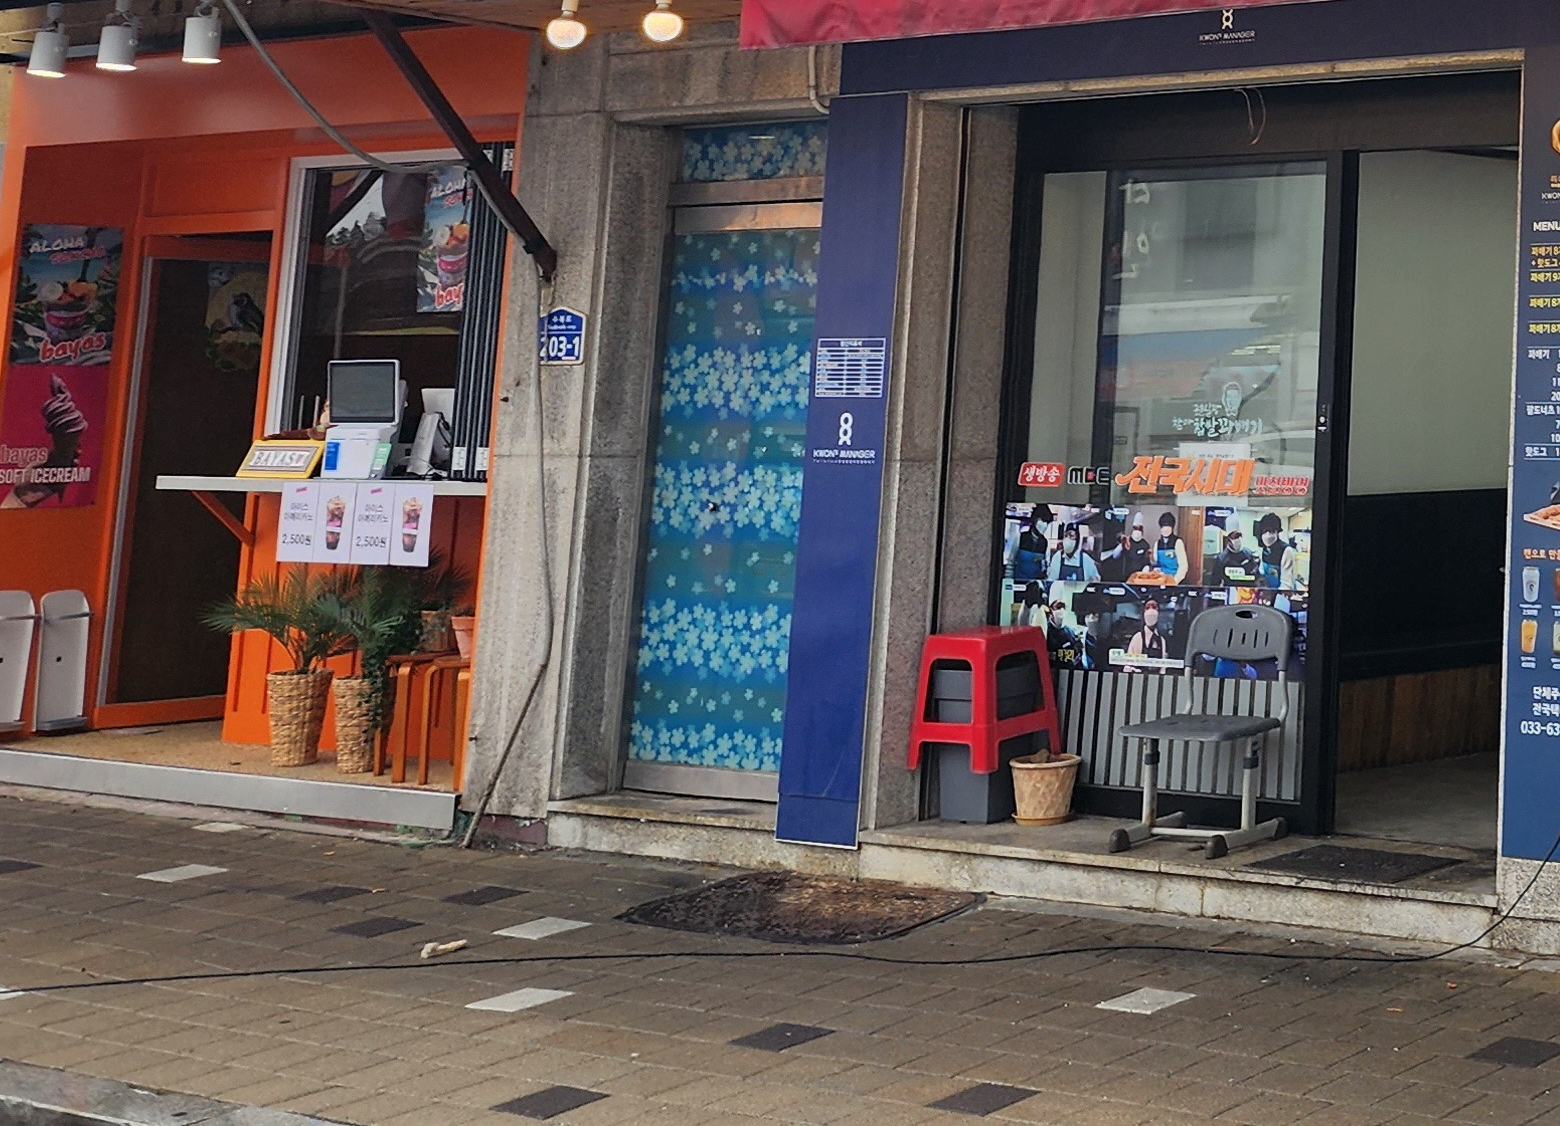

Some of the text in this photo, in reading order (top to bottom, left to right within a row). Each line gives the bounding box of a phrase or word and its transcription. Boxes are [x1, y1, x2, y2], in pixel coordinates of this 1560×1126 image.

[39, 332, 107, 363] bayas
[253, 451, 297, 467] BAYAS
[30, 466, 92, 484] ICECREAM
[1023, 465, 1062, 484] 생방송
[1114, 455, 1257, 496] 전국시대
[282, 533, 312, 546] 2,500원
[356, 535, 388, 549] 2,500원
